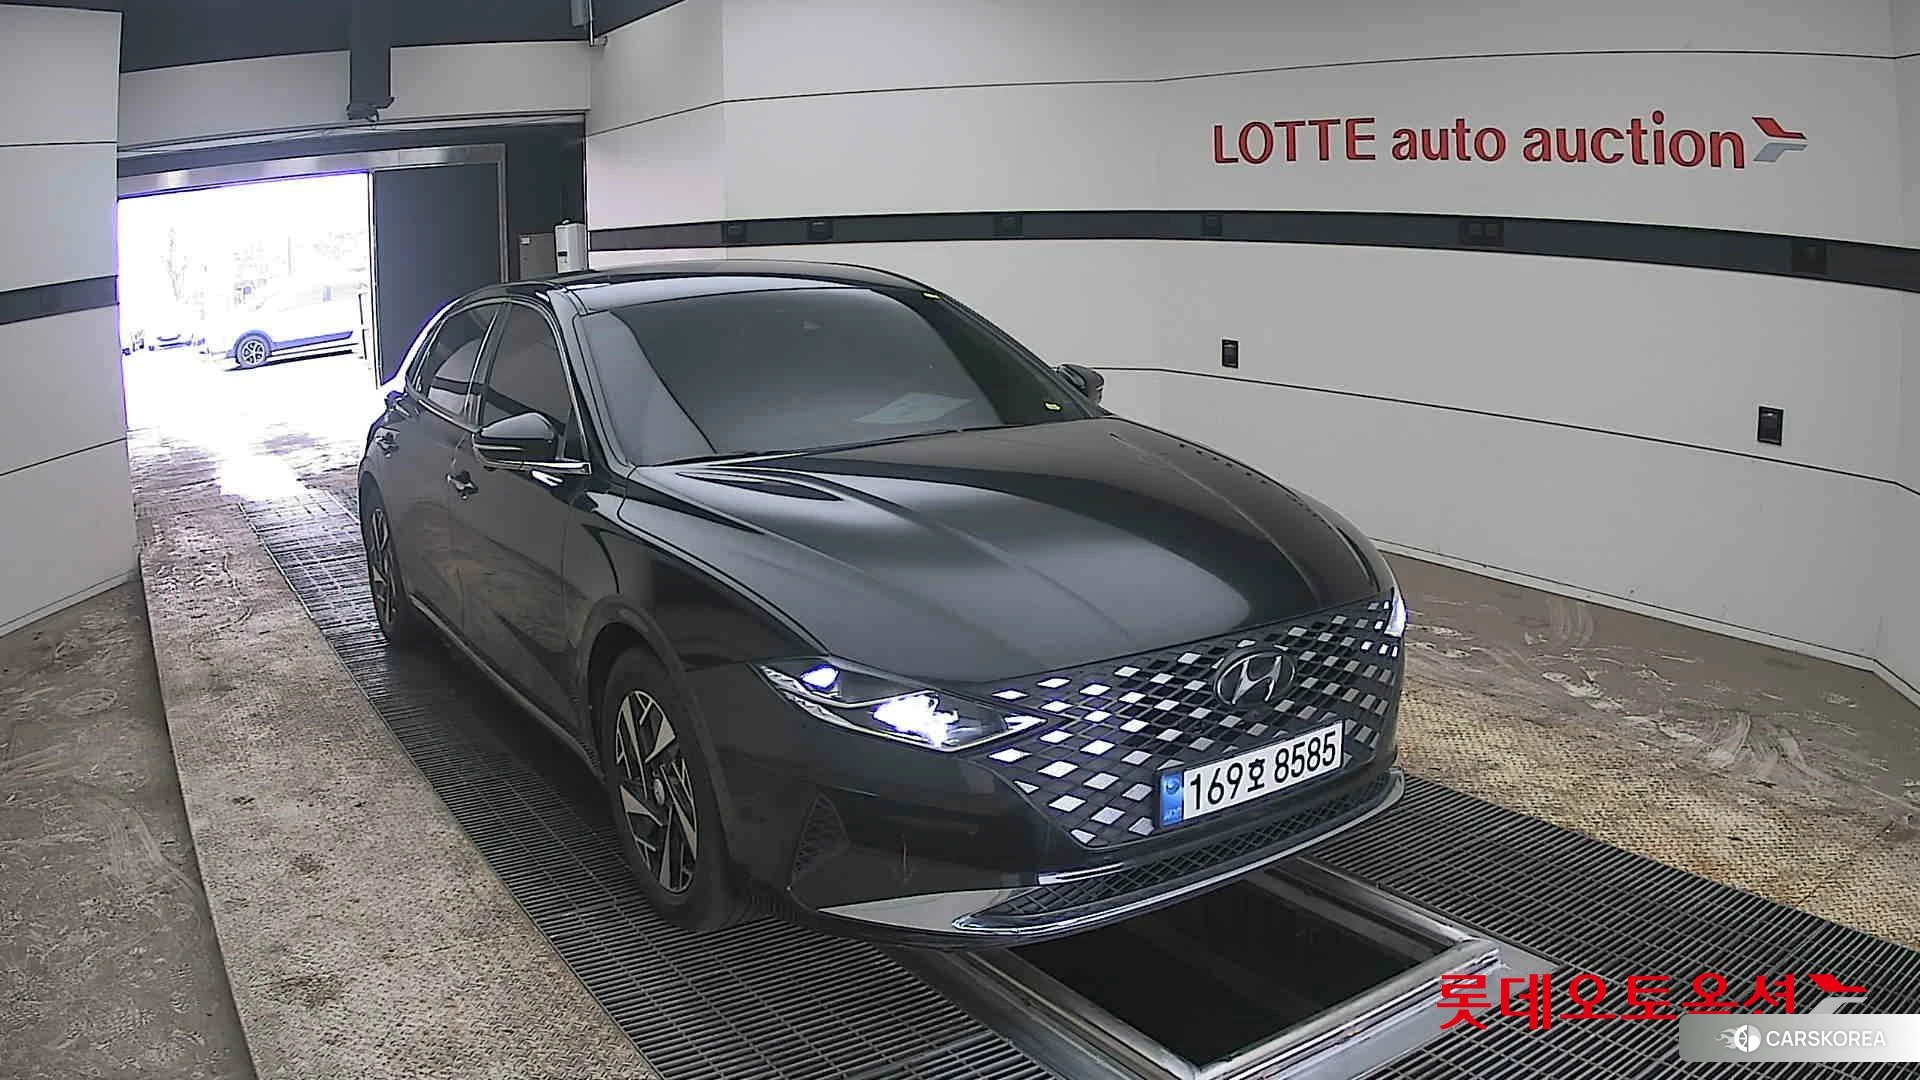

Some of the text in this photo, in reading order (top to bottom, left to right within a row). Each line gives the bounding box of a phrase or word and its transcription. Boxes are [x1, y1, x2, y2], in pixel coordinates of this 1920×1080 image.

[1213, 110, 1746, 169] LOTTE auto auction
[1189, 730, 1337, 811] 169호 8585
